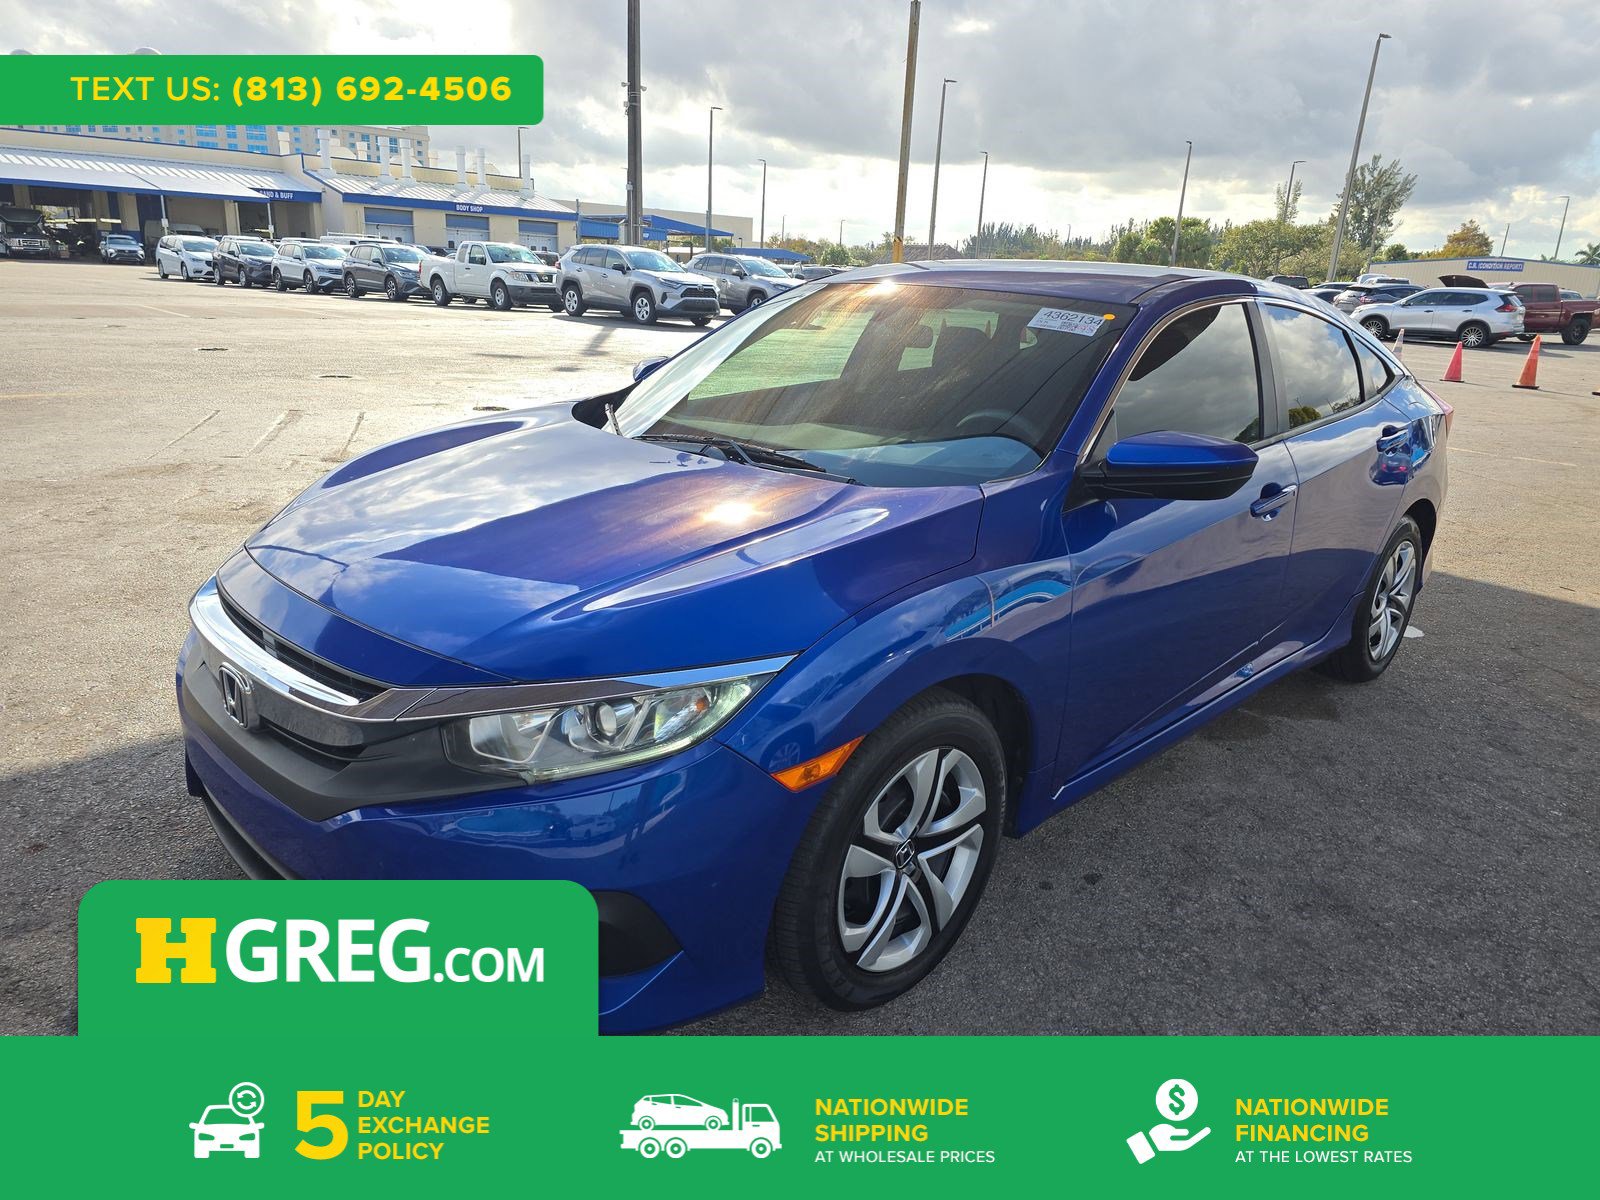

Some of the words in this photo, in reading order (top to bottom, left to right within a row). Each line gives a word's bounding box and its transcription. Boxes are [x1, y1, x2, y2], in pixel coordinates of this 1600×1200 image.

[456, 204, 470, 212] BODY
[470, 205, 483, 213] SHOP
[1043, 310, 1103, 326] 4362134
